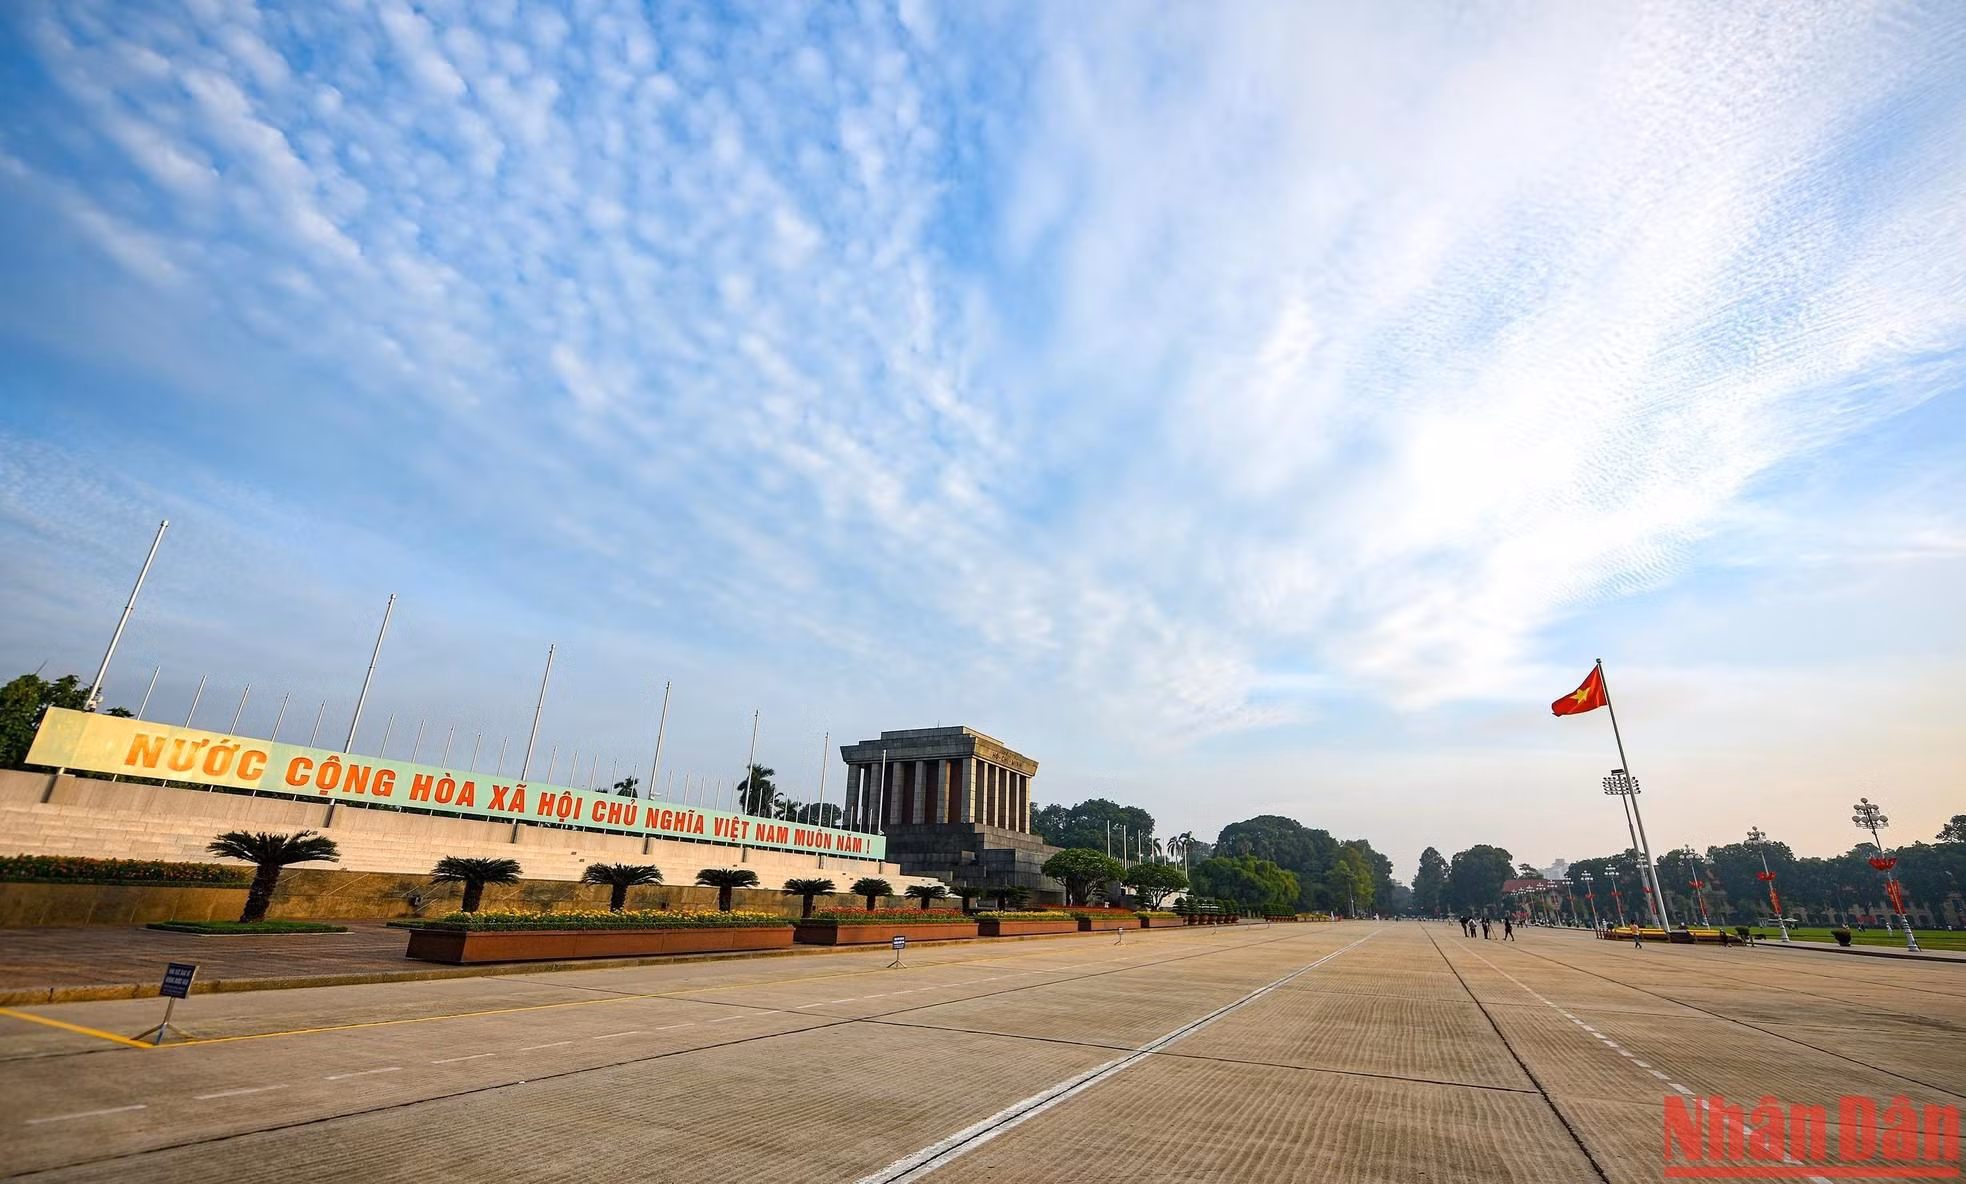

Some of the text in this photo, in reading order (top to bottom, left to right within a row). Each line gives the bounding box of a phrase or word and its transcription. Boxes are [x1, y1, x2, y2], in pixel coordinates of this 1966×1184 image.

[124, 734, 870, 854] NƯỚC CỘNG HÒA XÃ HỘI CHỦ NGHĨA VIỆT NAM MUÔN NĂM !
